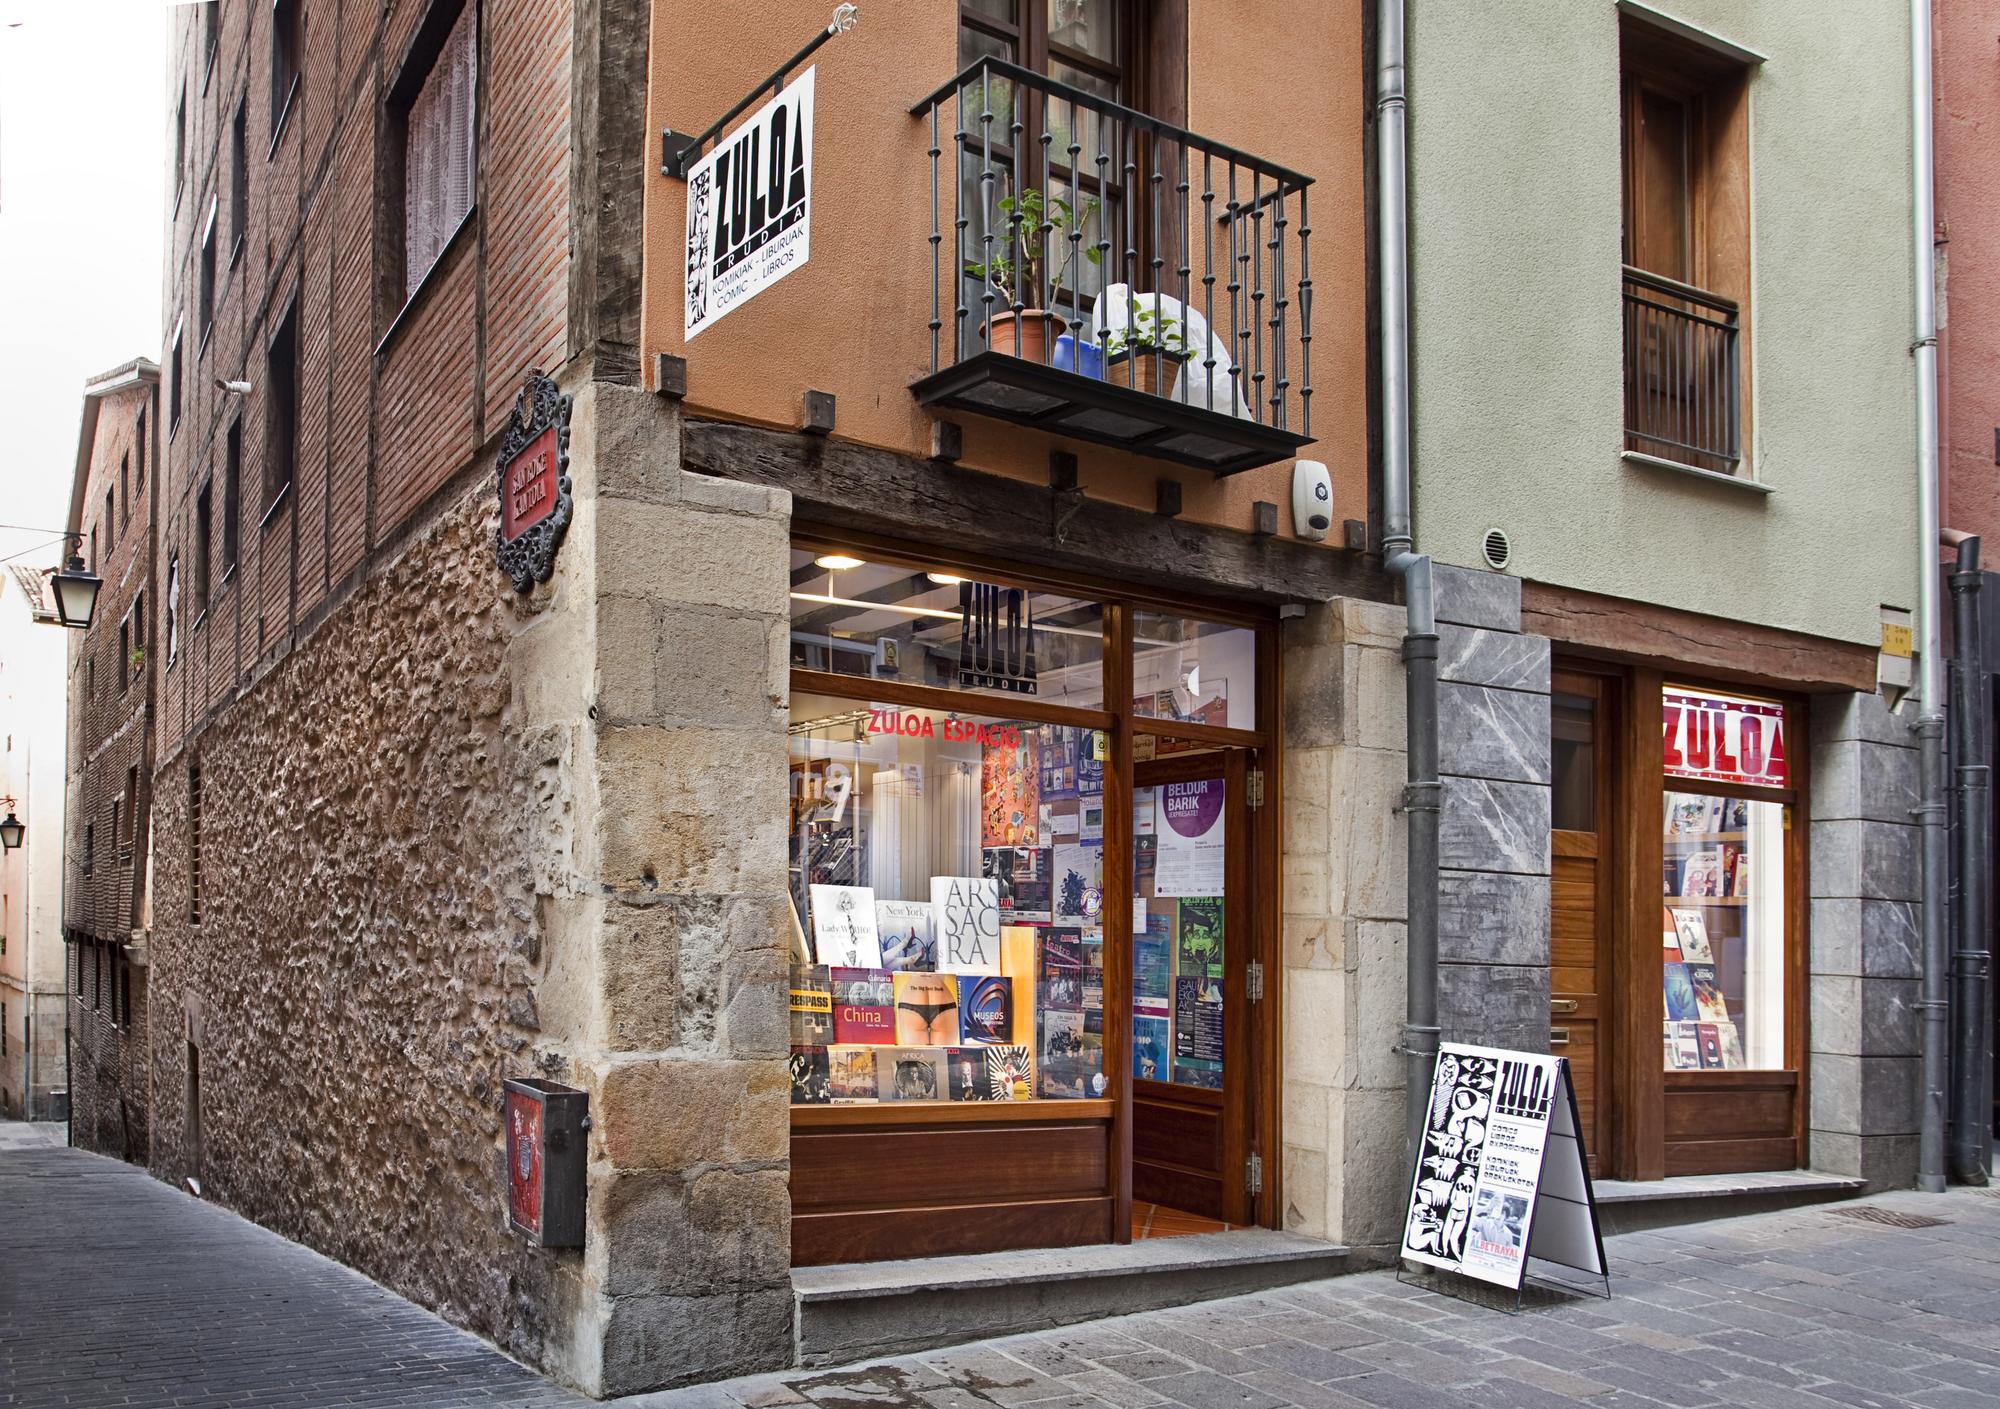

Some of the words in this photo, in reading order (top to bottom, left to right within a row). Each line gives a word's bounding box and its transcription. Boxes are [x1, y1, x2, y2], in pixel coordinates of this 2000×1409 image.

[713, 91, 806, 262] ZULOA
[715, 209, 802, 277] IRUDIA
[712, 260, 753, 296] KOMIKIAK
[761, 225, 805, 266] LIBURUAK
[716, 279, 748, 308] COMIC
[762, 248, 794, 279] LIBROS
[959, 581, 1037, 679] ZULOA
[961, 673, 1036, 693] IRUDIA
[867, 709, 934, 738] ZULOA
[943, 718, 1021, 750] ESPACIO
[1662, 705, 1785, 776] ZULOA
[1168, 780, 1208, 797] BELDUR
[1168, 796, 1200, 811] BARIK
[944, 879, 998, 907] ARS
[886, 904, 904, 915] New
[905, 904, 925, 917] York
[945, 905, 998, 937] SAC
[946, 932, 989, 965] RA
[790, 994, 829, 1008] RESPASS
[1178, 990, 1195, 1001] EKO
[843, 1007, 881, 1024] China
[973, 1011, 1004, 1021] MUSEOS
[1496, 1060, 1550, 1113] ZULOA
[1495, 1107, 1547, 1121] IRUDIA
